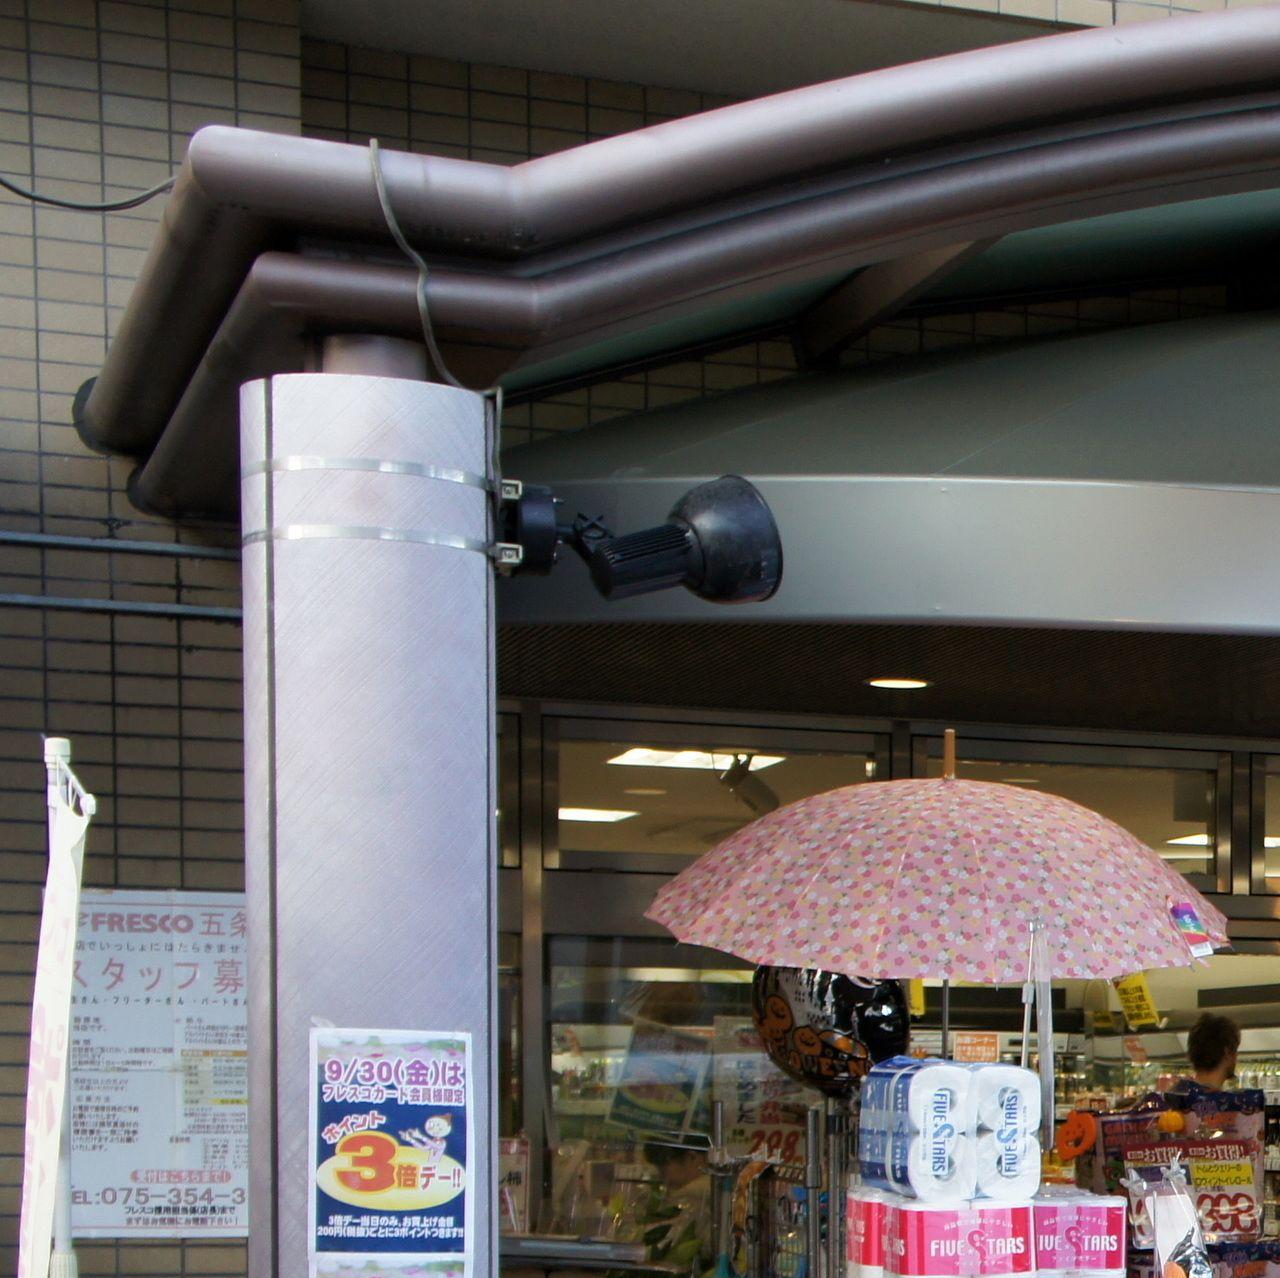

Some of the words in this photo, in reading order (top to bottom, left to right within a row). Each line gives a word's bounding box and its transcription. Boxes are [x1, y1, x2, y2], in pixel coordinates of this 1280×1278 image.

[91, 912, 194, 933] FRESCO
[323, 1057, 464, 1087] 9/30(金)は
[322, 1110, 386, 1145] ポイント
[71, 1187, 246, 1206] EL:075-354-3
[1038, 1235, 1062, 1250] IVE
